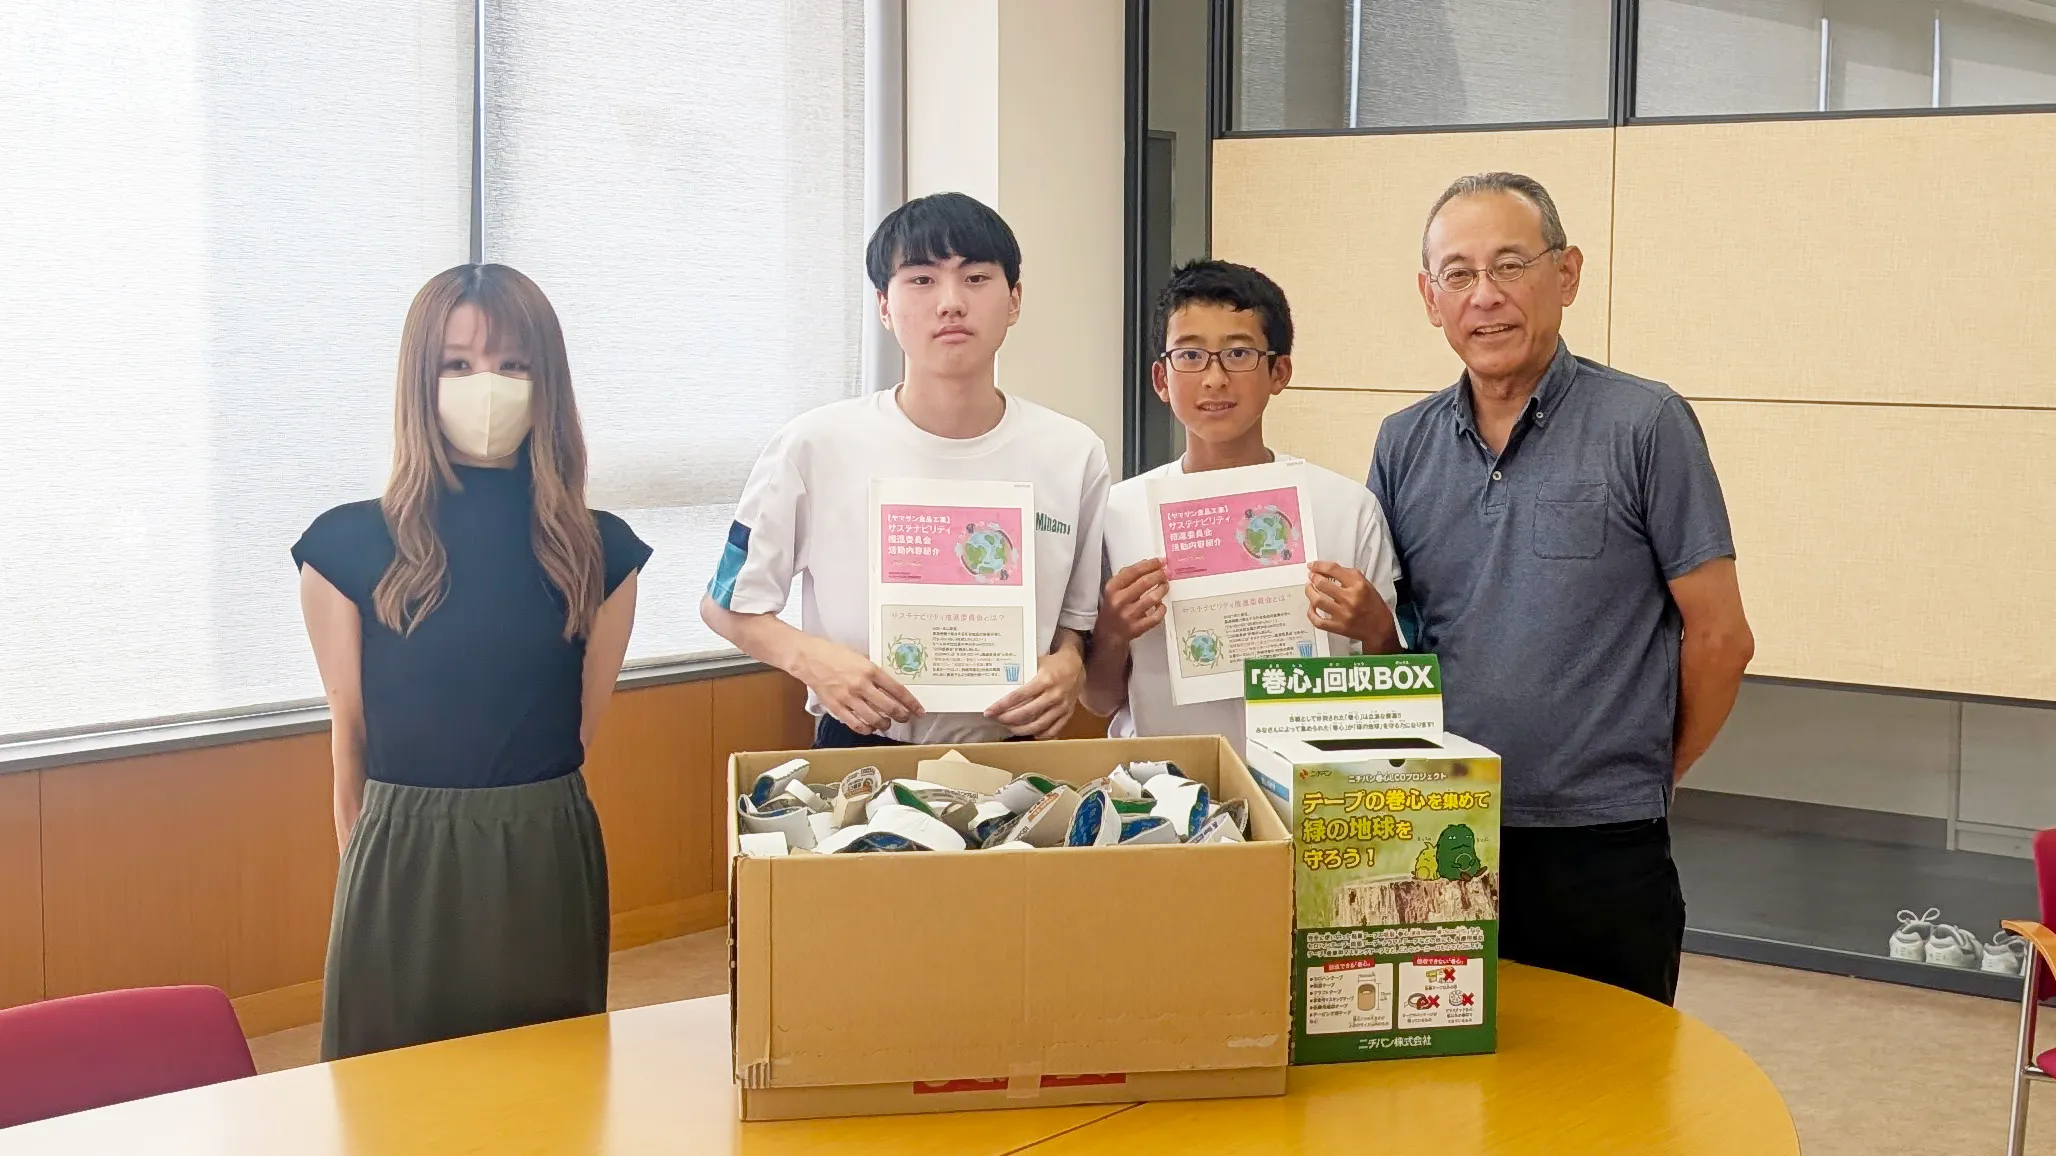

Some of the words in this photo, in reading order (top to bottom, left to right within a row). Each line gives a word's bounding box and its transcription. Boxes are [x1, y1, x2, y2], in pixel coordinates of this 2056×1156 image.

[888, 524, 952, 534] サステナビリティ
[1036, 512, 1071, 535] Minami
[1168, 516, 1231, 530] サステナビリティ
[1251, 667, 1434, 694] 「巻心」回収BOX
[1303, 789, 1491, 814] テープの巻心を集めて
[1302, 815, 1413, 843] 緑の地球を
[1303, 847, 1376, 871] 守ろう！
[1358, 1035, 1432, 1050] ニチバン株式会社
